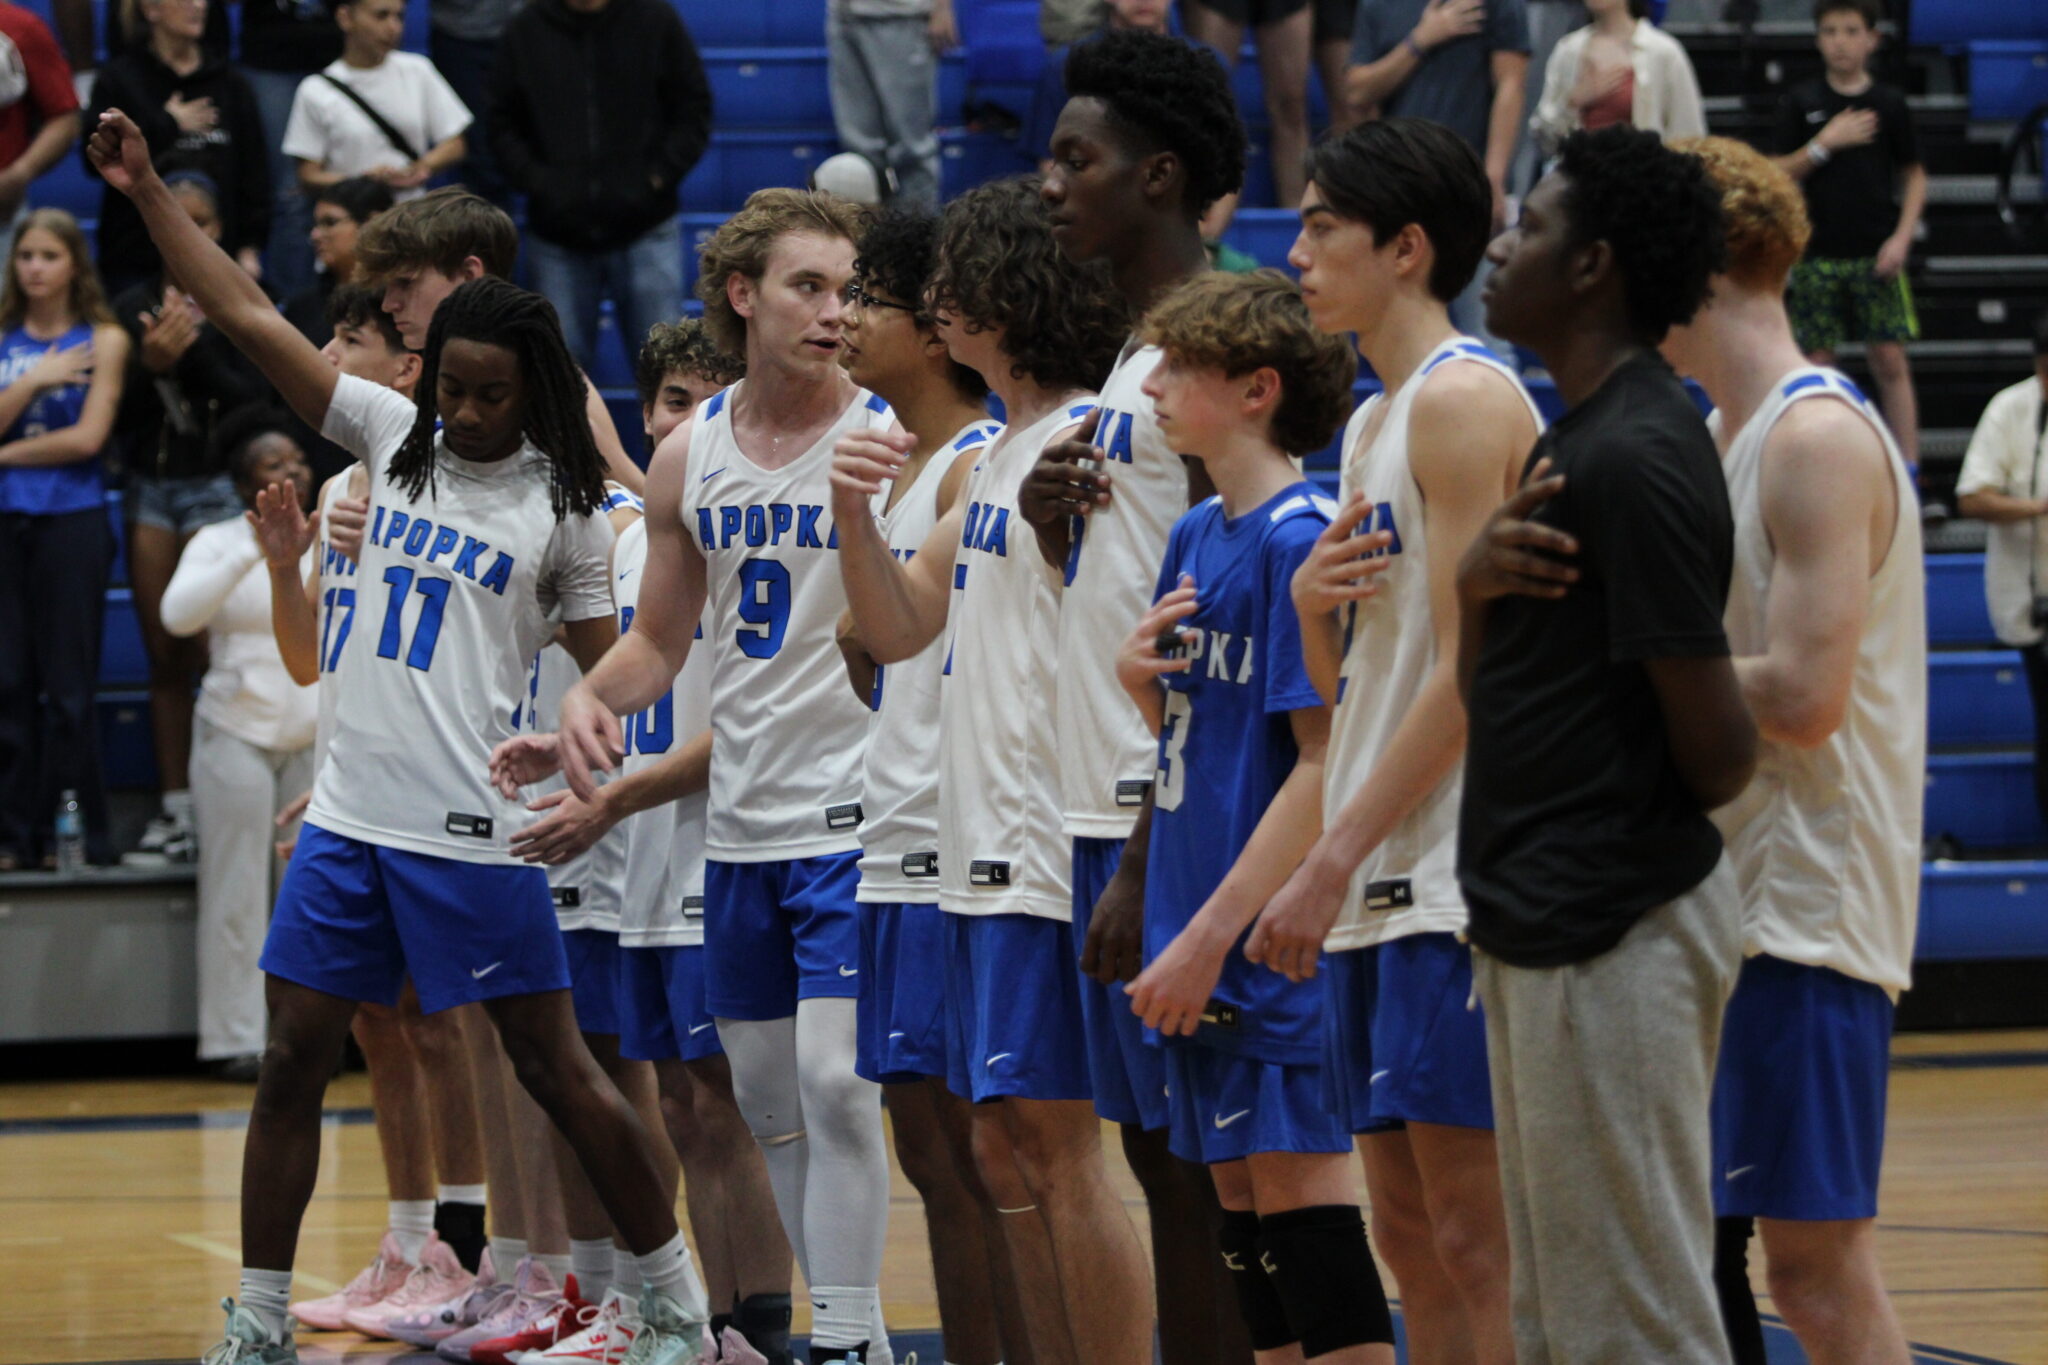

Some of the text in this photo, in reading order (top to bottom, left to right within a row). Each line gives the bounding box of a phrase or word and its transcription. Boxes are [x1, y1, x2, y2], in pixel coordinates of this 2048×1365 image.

[320, 588, 356, 673] 17
[376, 565, 451, 672] 11
[736, 558, 791, 659] 9
[1155, 688, 1193, 813] 3
[478, 822, 488, 832] M
[994, 868, 1002, 879] L
[1394, 887, 1405, 899] M
